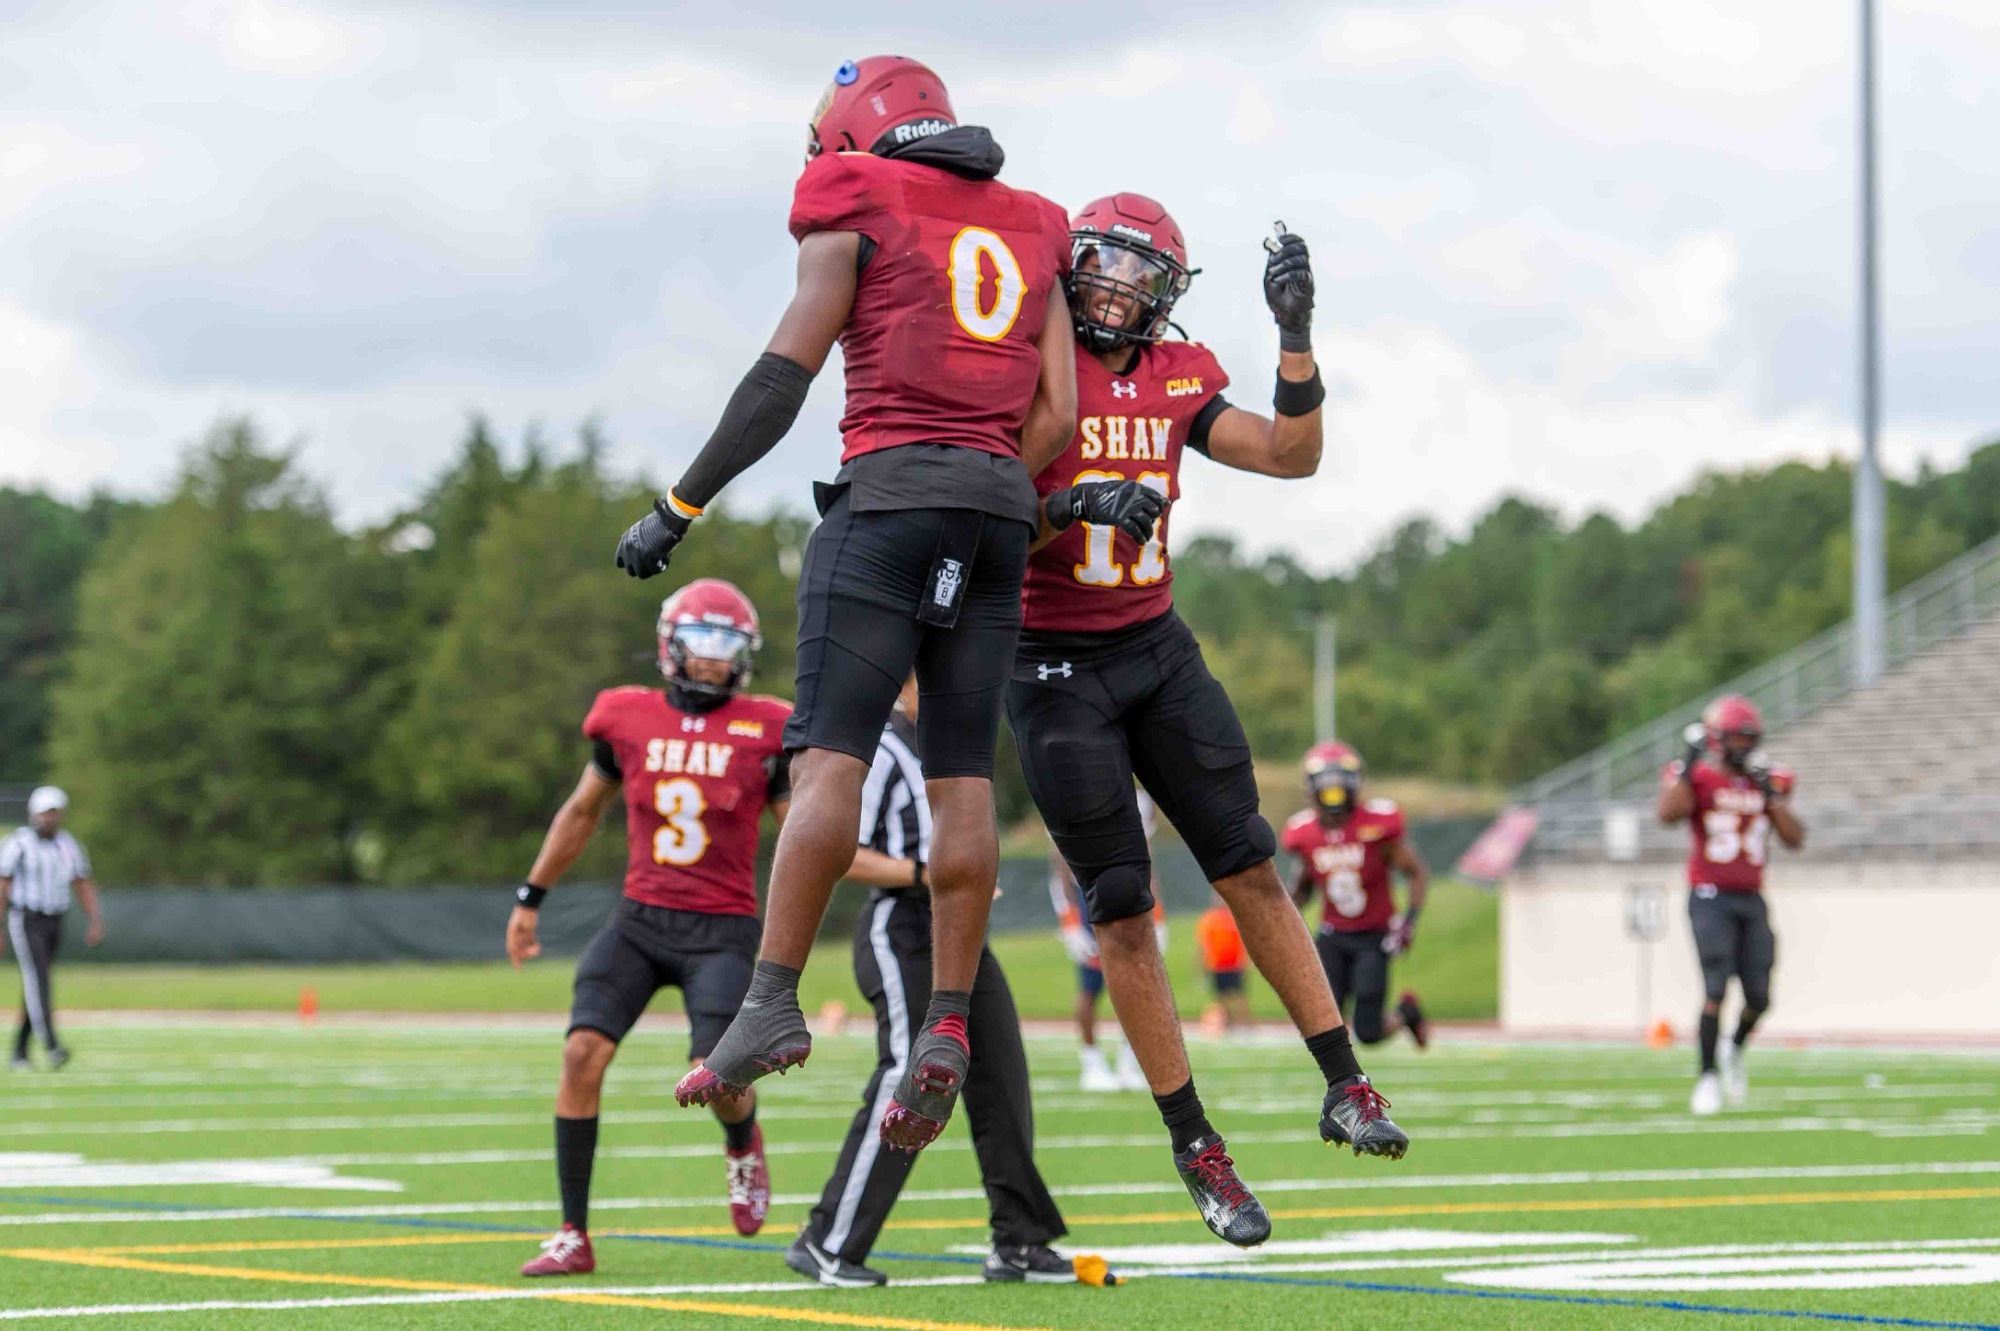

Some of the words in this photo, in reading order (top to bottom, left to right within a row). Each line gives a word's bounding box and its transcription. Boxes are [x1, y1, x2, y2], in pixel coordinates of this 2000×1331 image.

[946, 226, 1028, 342] 0
[1166, 377, 1203, 397] CIAA
[1080, 416, 1173, 460] SHAW
[645, 738, 734, 778] SHAW
[652, 776, 712, 866] 3
